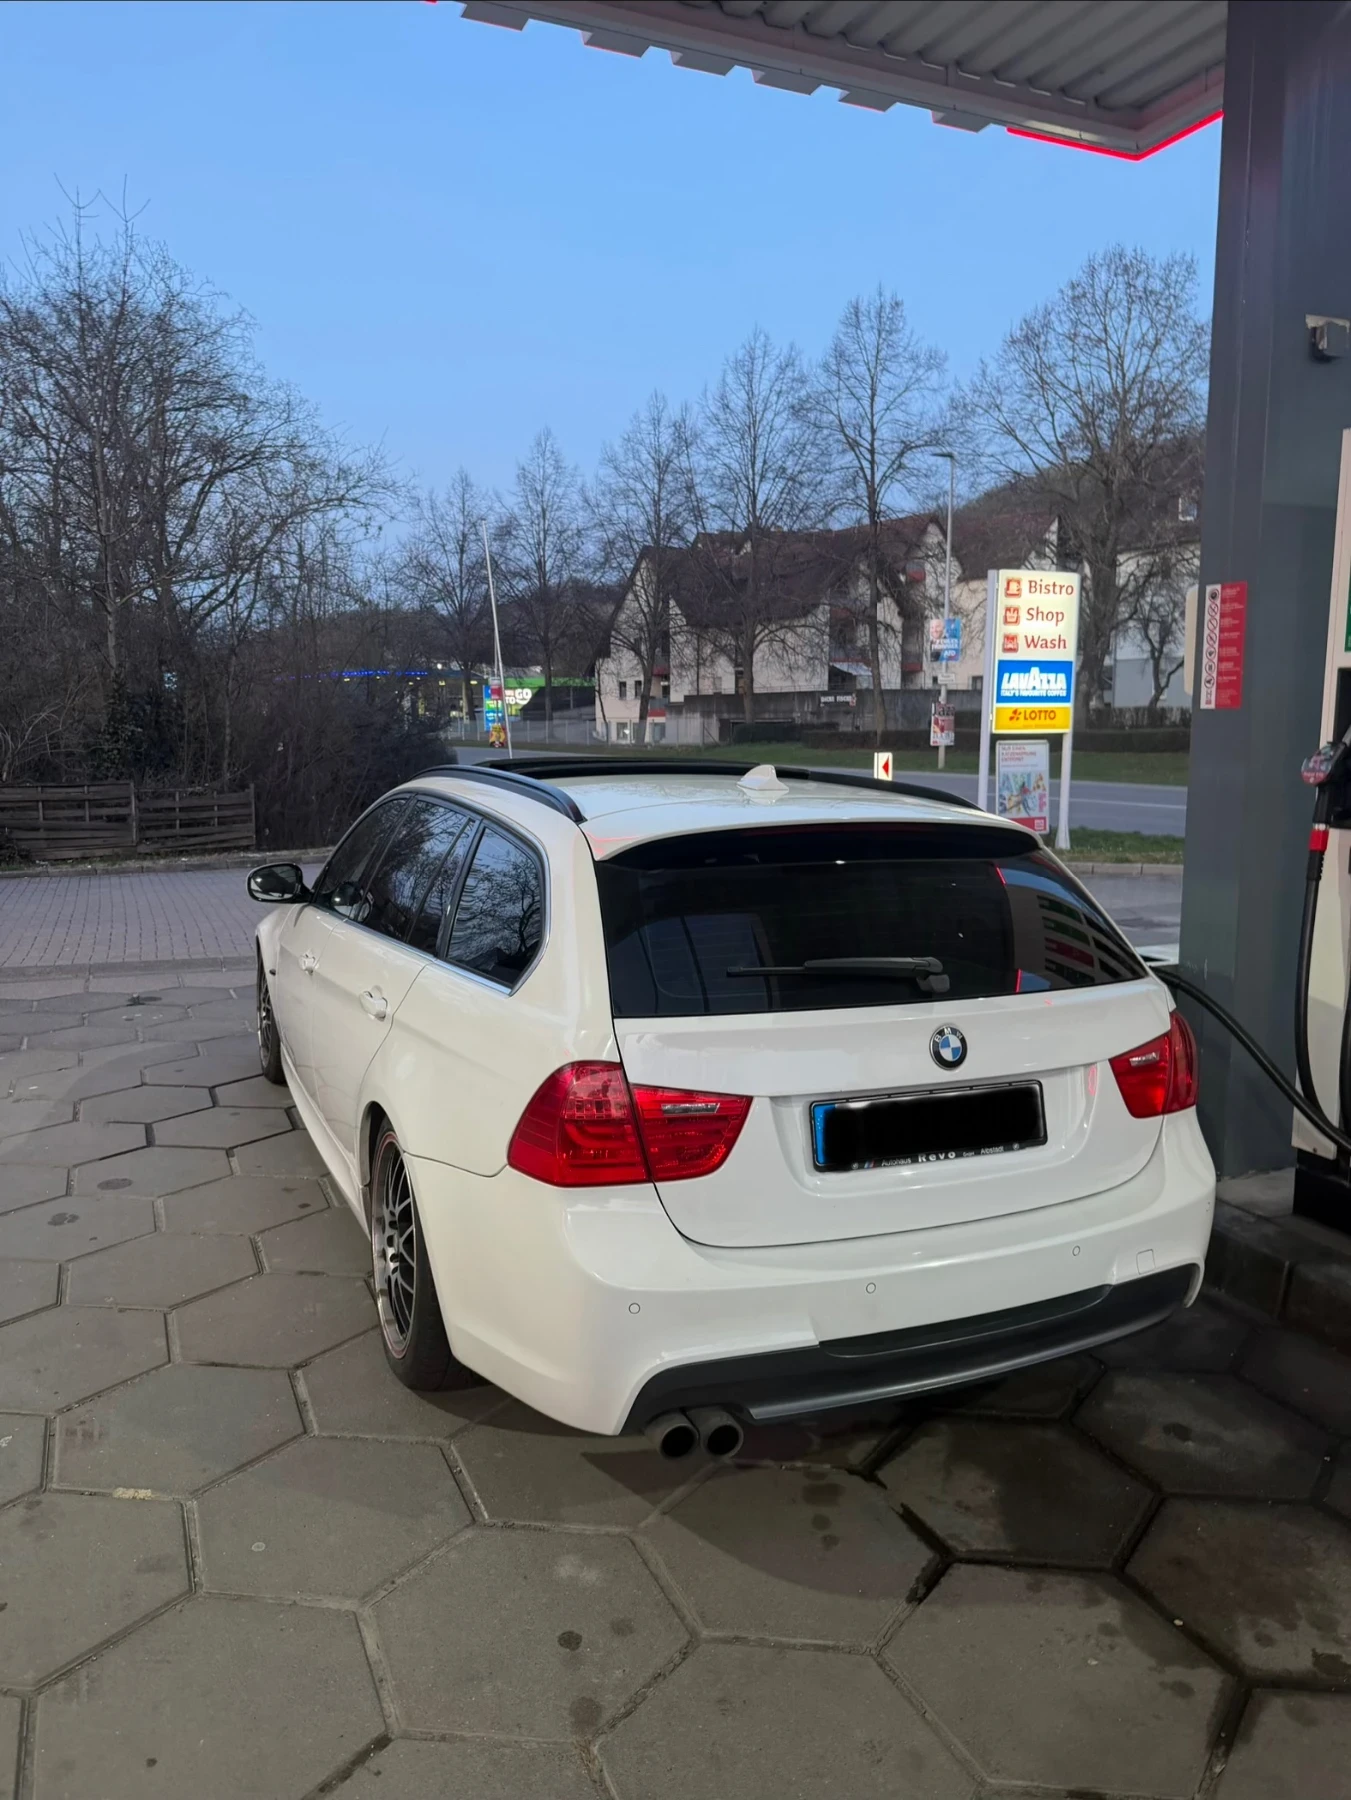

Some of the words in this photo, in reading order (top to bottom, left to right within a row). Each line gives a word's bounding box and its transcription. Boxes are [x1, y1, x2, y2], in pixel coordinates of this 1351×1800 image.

[1028, 579, 1074, 595] Bistro
[1026, 606, 1065, 627] Shop
[1024, 634, 1067, 649] Wash
[1001, 667, 1067, 690] LAVAZZA
[1023, 709, 1056, 720] LOTTO
[934, 1026, 963, 1043] BMW
[881, 1157, 912, 1166] Autohaus
